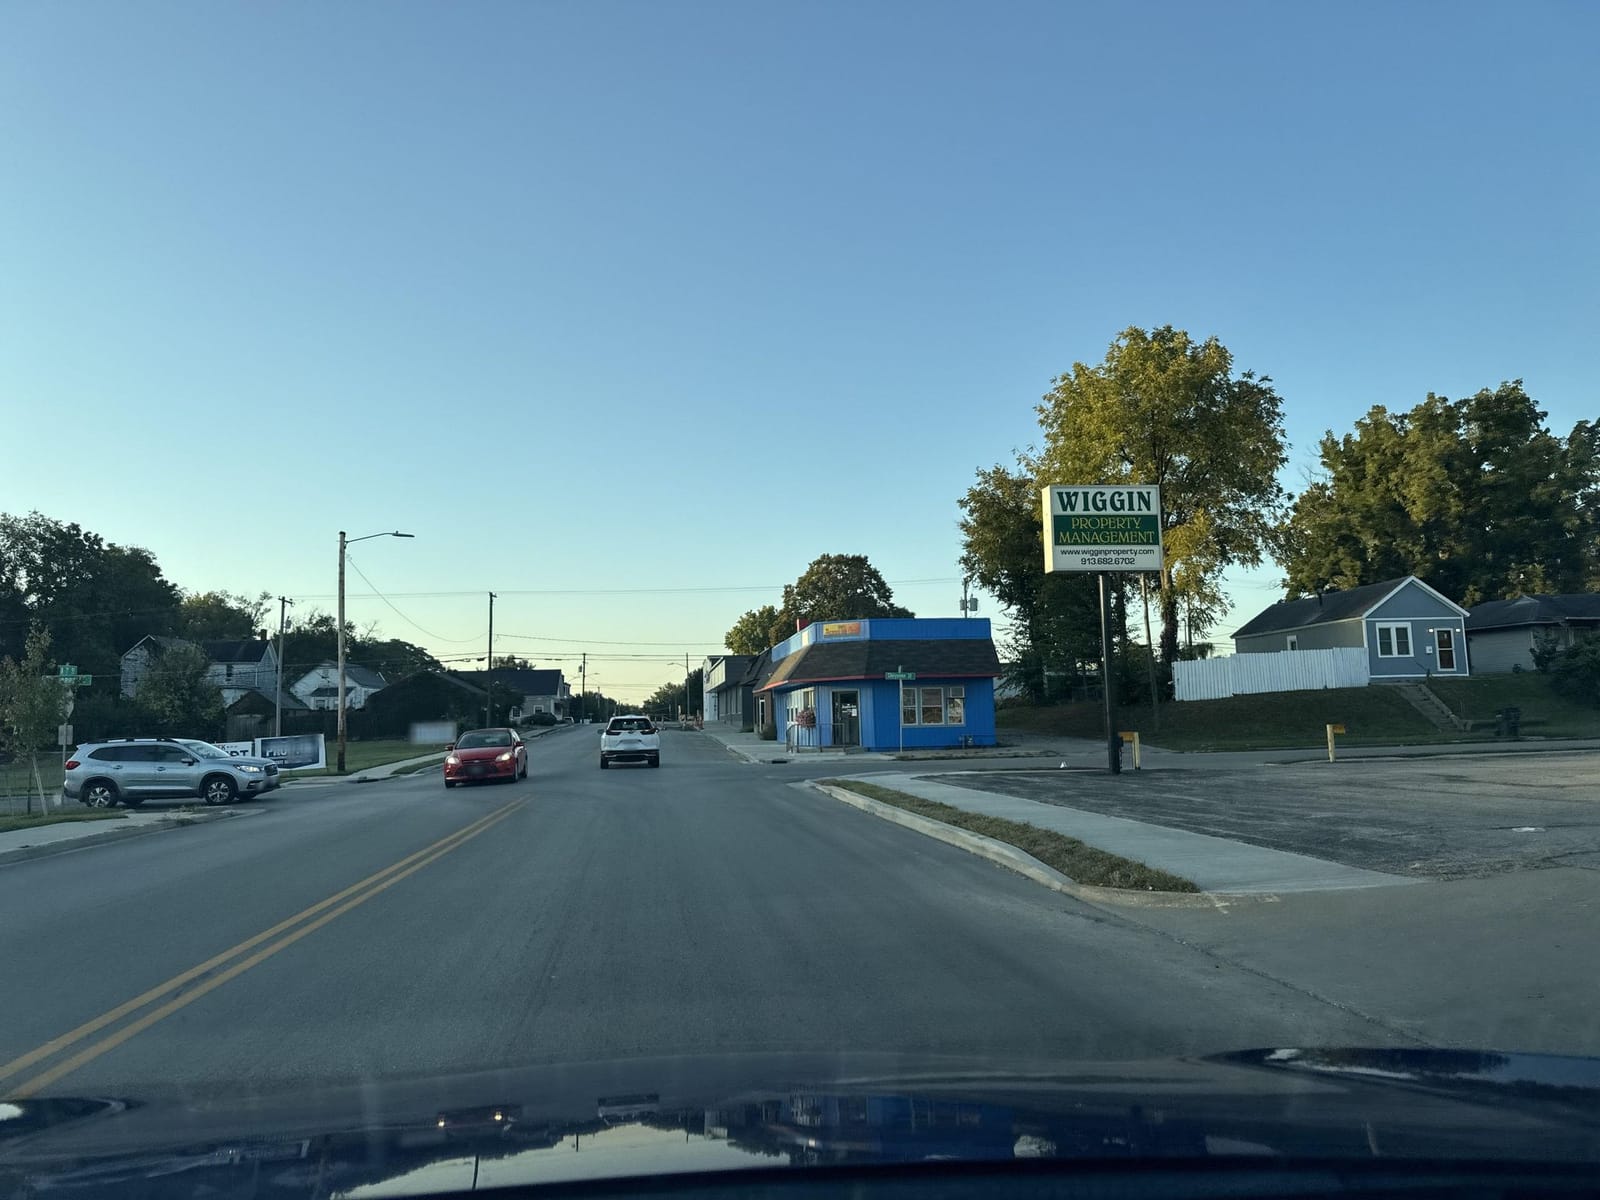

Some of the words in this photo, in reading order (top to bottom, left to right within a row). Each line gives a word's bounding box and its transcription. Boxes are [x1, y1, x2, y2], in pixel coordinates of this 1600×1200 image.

[1056, 491, 1151, 512] WIGGIN
[1071, 517, 1142, 529] PROPERTY
[1059, 531, 1155, 543] MANAGEMENT
[1060, 548, 1155, 557] www.wigginproperty.com
[1080, 557, 1136, 566] 913.682.6702
